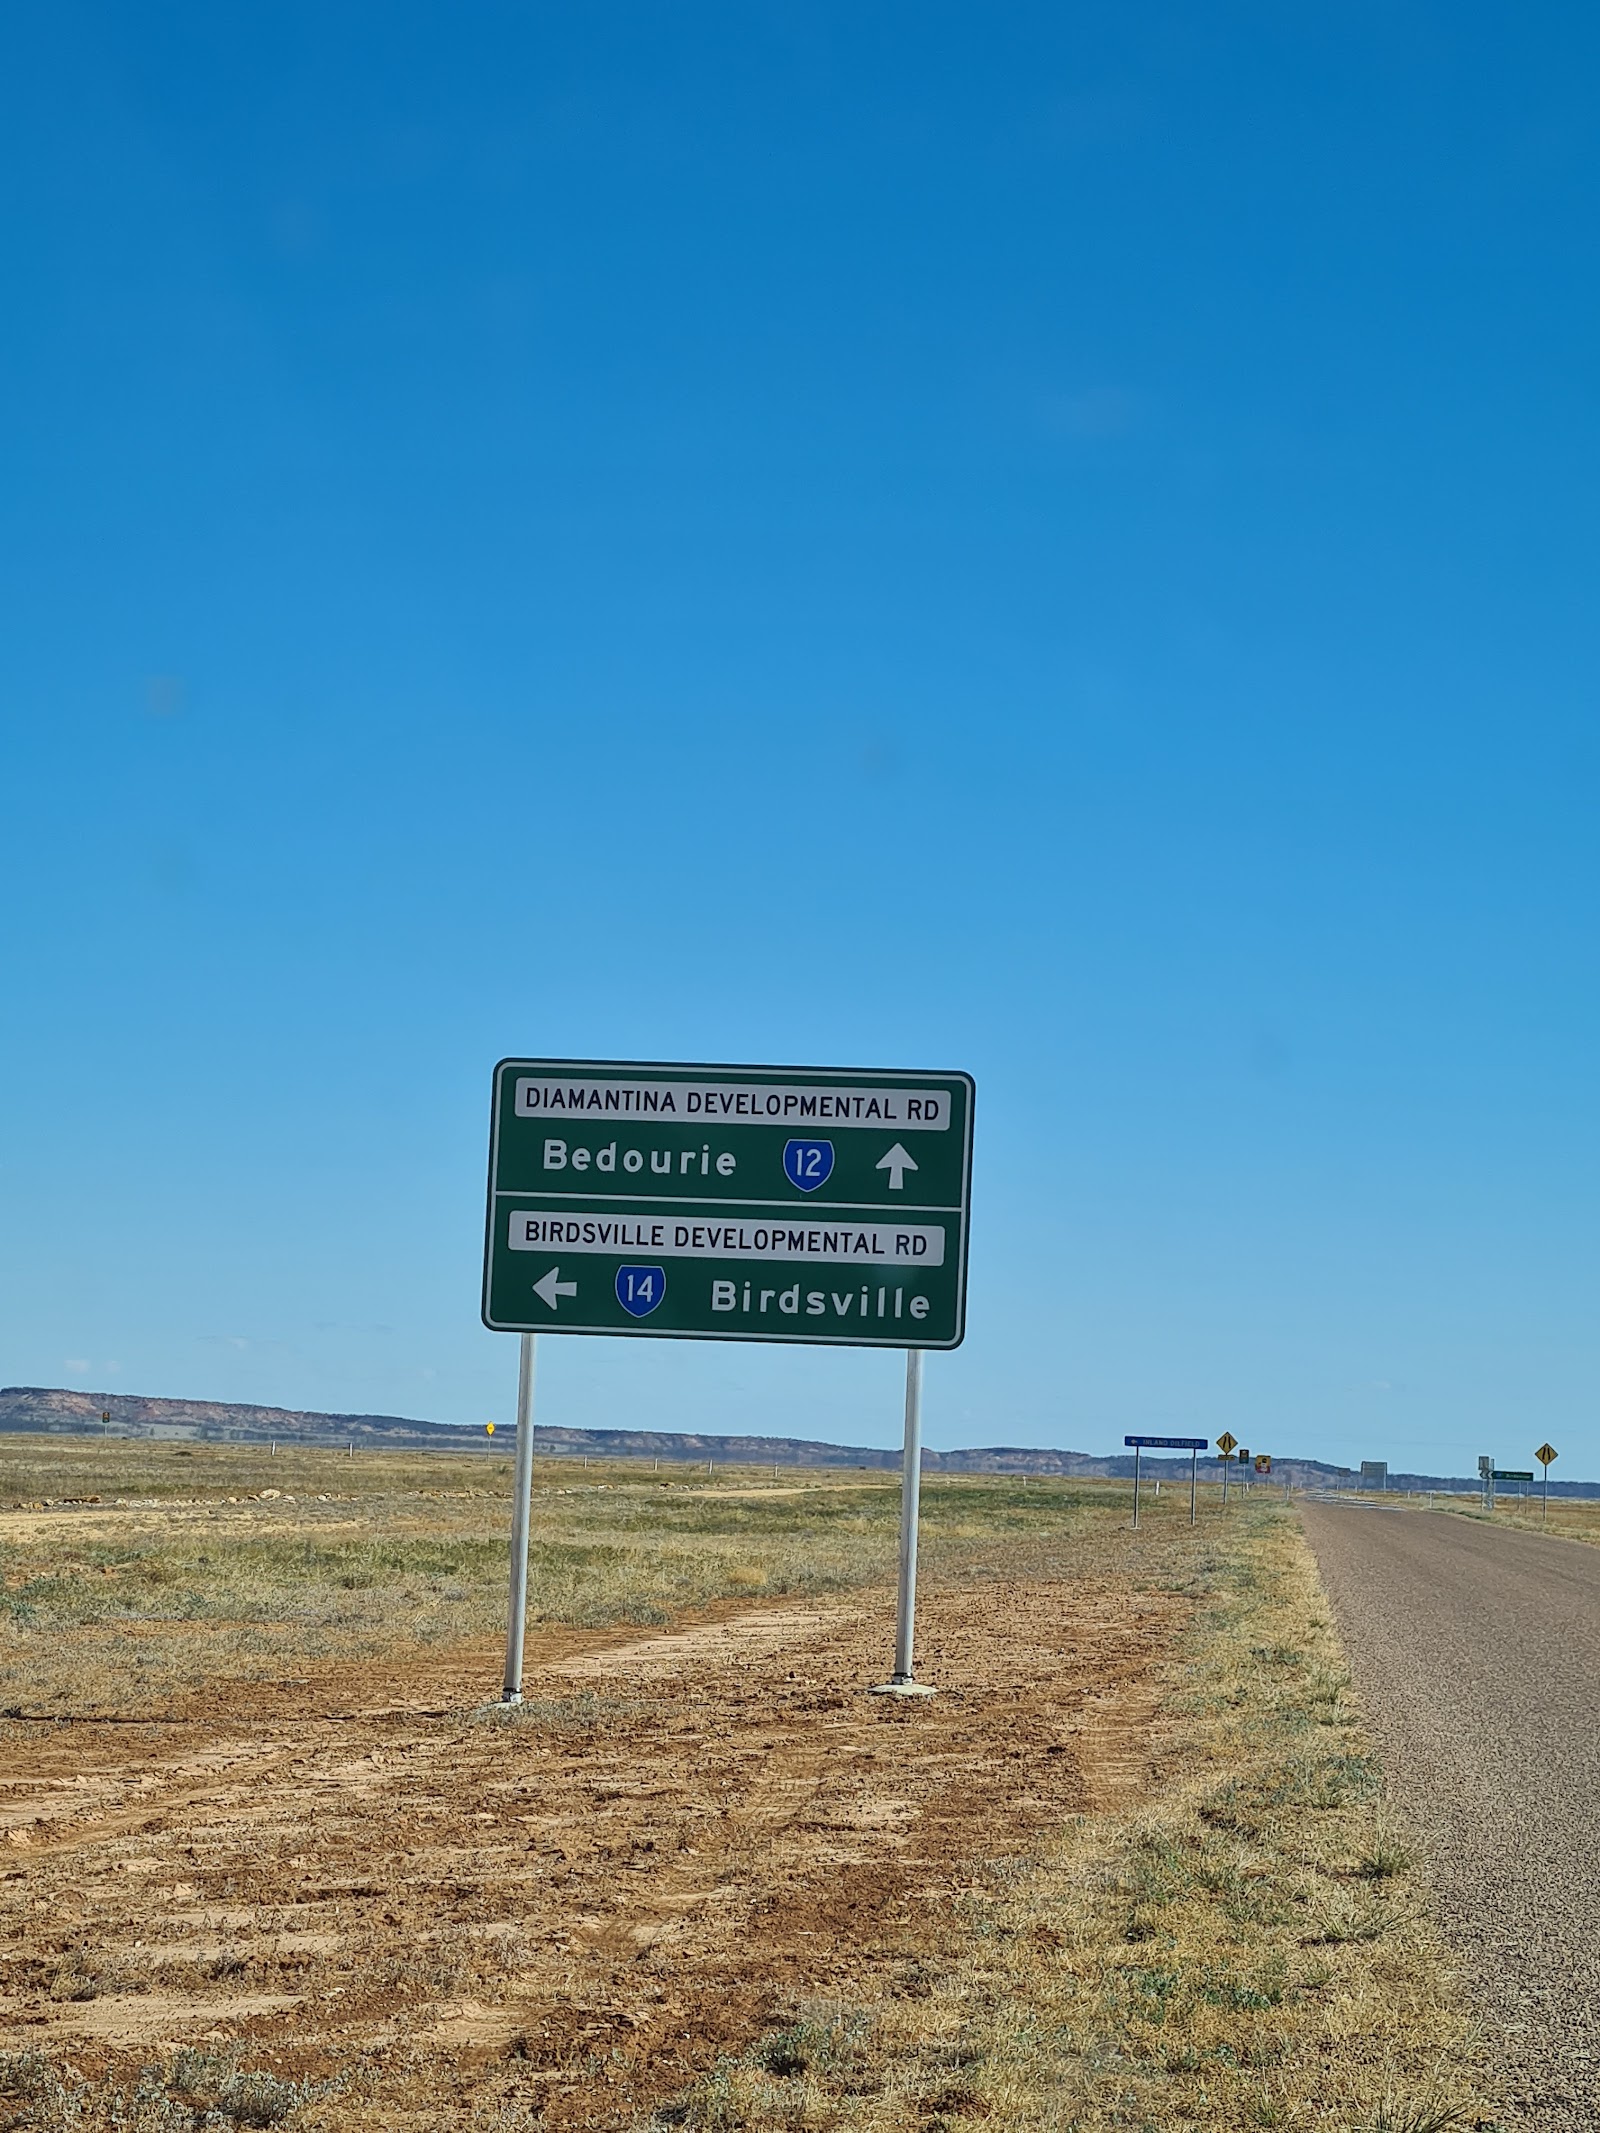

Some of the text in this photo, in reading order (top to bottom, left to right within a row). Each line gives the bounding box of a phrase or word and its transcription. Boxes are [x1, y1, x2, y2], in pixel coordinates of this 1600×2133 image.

[526, 1087, 940, 1120] DIAMANTINA DEVELOPMENTAL RD
[543, 1140, 737, 1176] Bedourie
[797, 1148, 820, 1177] 12
[525, 1221, 928, 1256] BIRDSVILLE DEVELOPMENTAL RD
[627, 1274, 653, 1302] 14
[712, 1281, 930, 1319] Birdsville
